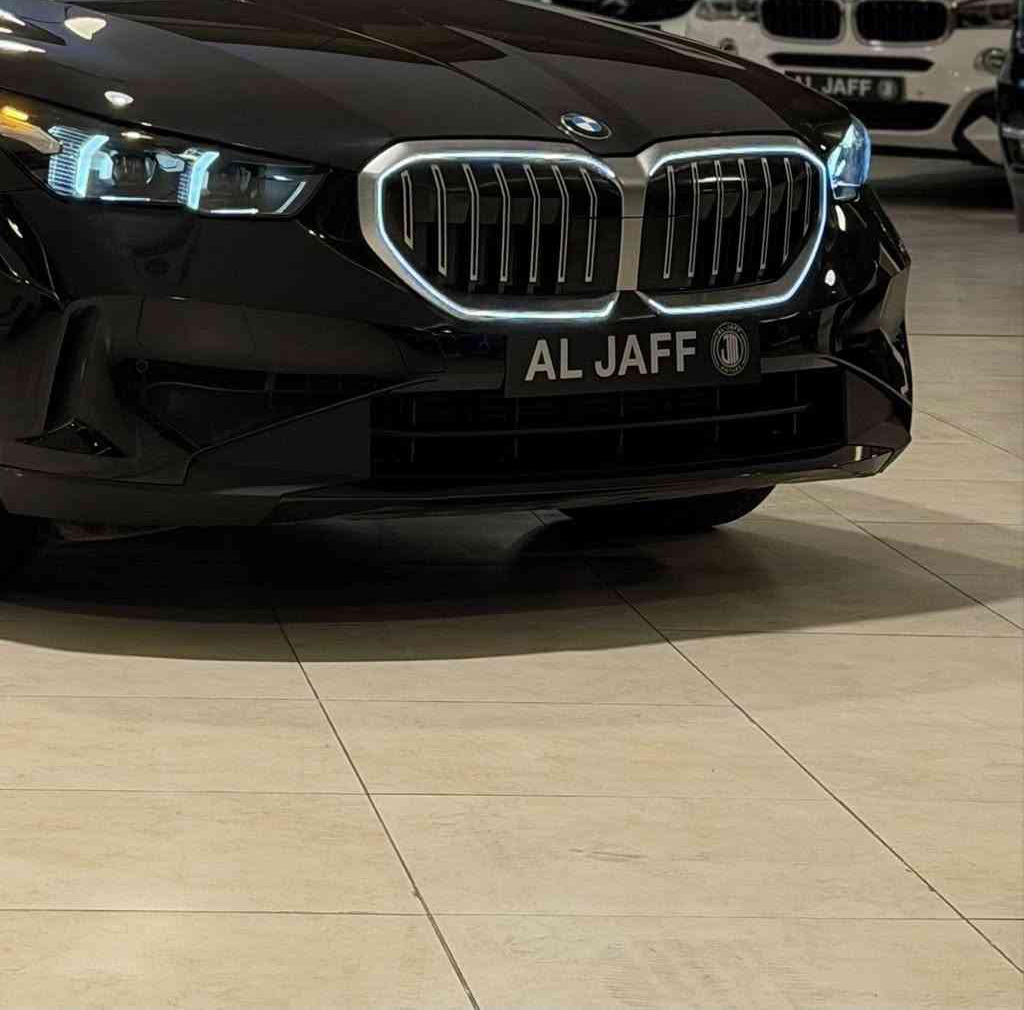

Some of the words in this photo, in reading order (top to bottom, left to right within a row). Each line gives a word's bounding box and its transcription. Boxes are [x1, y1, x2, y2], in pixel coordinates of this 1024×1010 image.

[821, 77, 872, 96] JAFF
[524, 338, 583, 381] AL
[594, 331, 697, 377] JAFF
